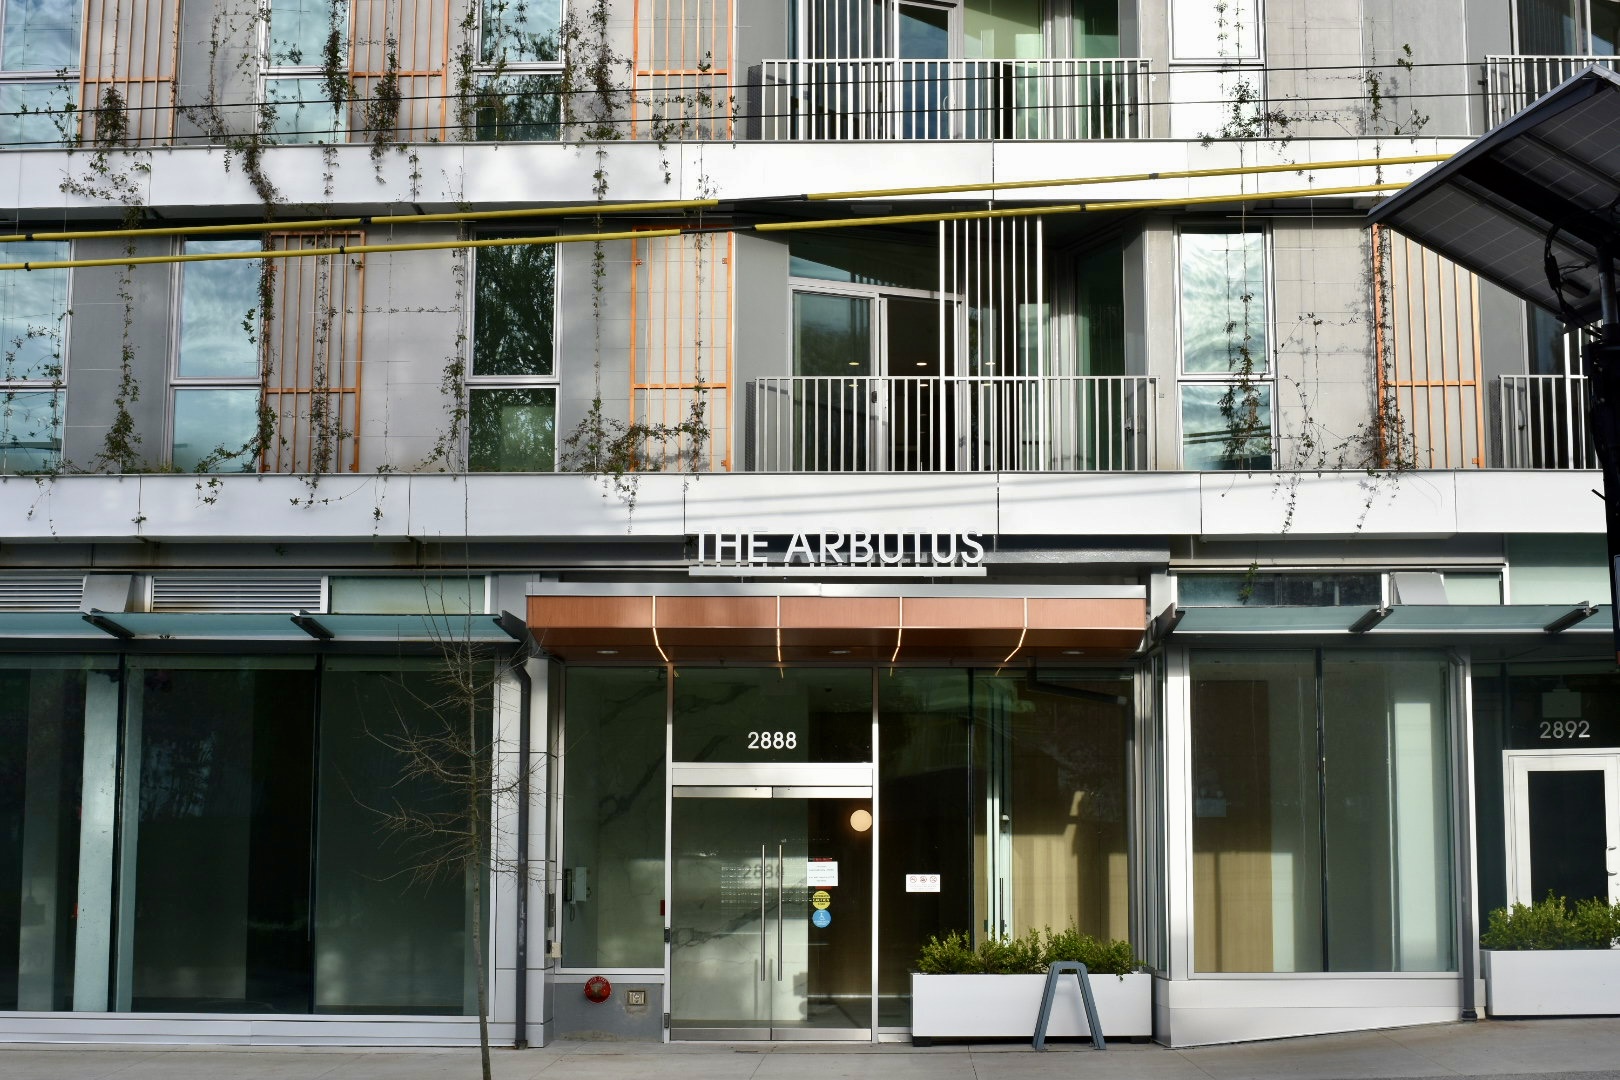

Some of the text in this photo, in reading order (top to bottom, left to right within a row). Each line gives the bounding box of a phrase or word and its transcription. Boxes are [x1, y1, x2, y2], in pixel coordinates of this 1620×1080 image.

[693, 527, 984, 564] THE ARBUTUS
[1540, 720, 1591, 739] 2892
[747, 731, 797, 749] 2888
